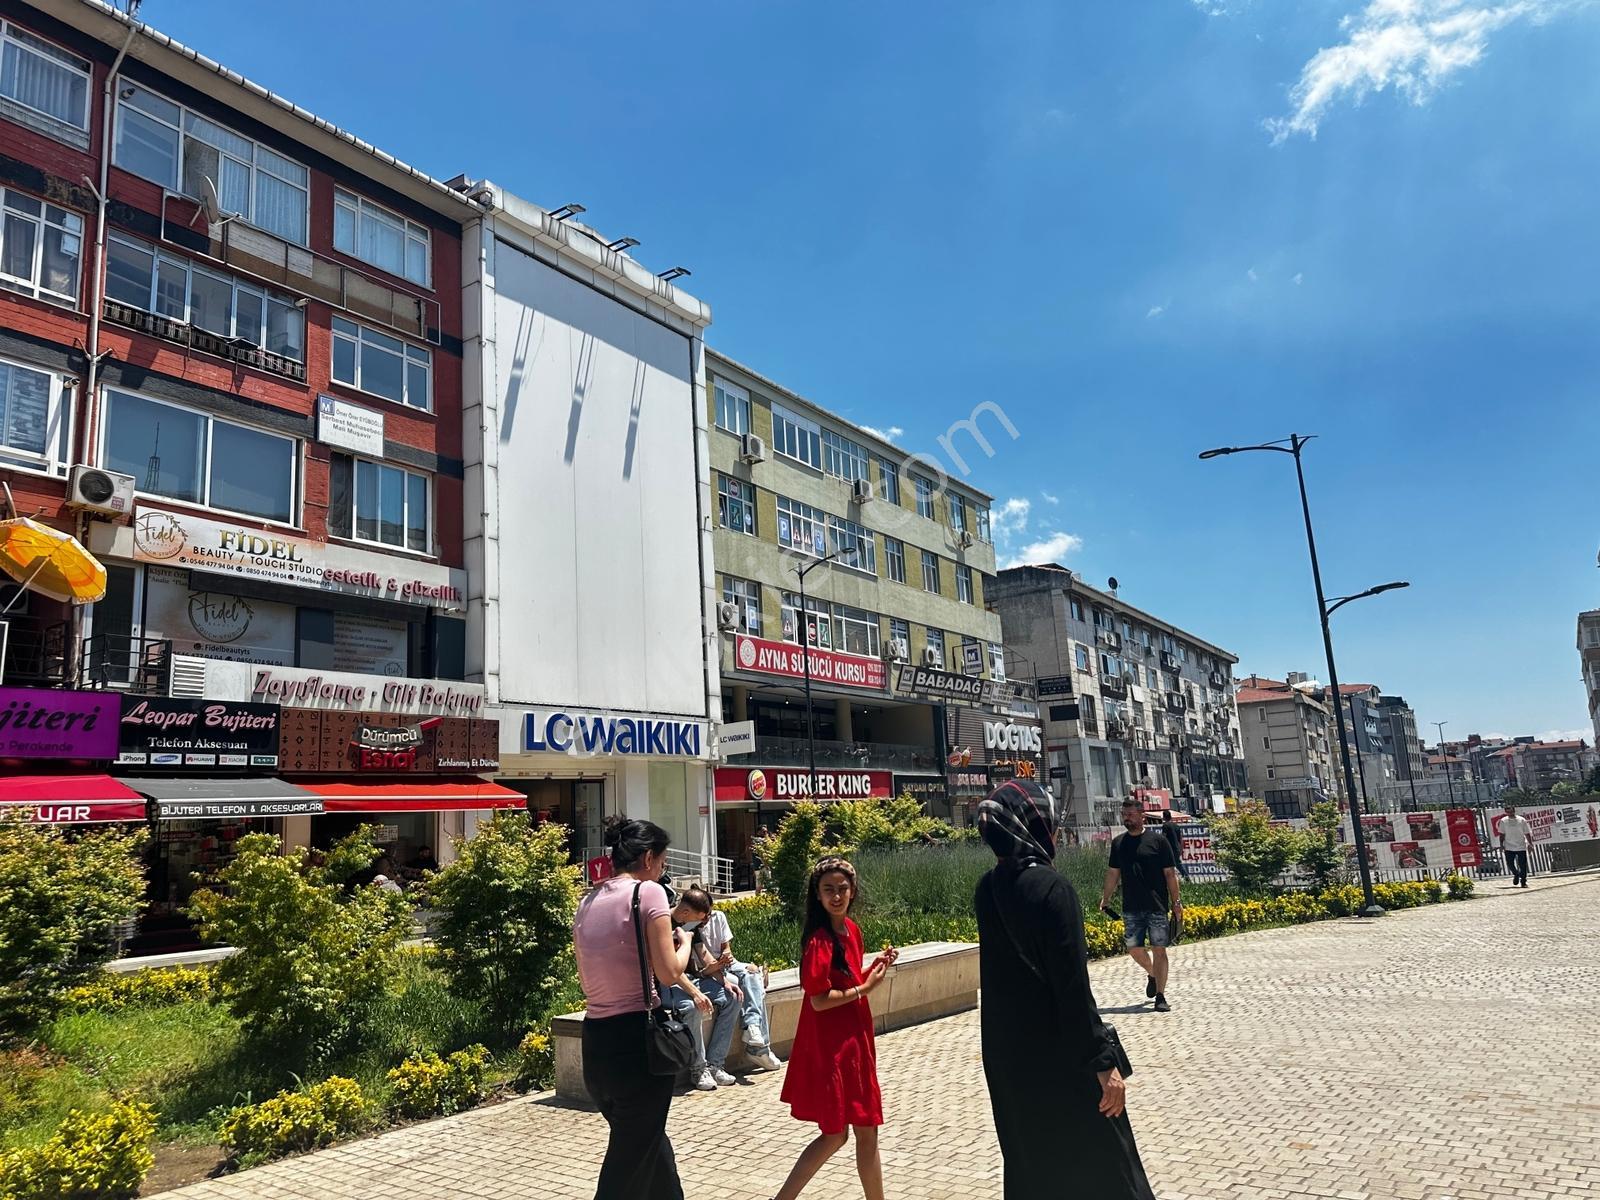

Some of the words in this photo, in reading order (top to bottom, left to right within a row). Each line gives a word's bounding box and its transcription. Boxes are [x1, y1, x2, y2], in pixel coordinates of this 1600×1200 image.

[321, 414, 346, 425] Serbest
[219, 529, 303, 564] FİDEL
[189, 558, 205, 566] 0546
[205, 560, 218, 569] 477
[226, 563, 235, 571] 04
[260, 569, 273, 577] 474
[272, 571, 280, 579] 94
[280, 572, 287, 580] 04
[193, 546, 234, 560] BEAUTY
[250, 556, 286, 570] TOUCH
[288, 563, 324, 576] STUDIO
[323, 568, 382, 589] estetik
[387, 578, 398, 592] &
[401, 580, 463, 603] güzellik
[205, 643, 250, 656] Fidelbeautyts
[759, 647, 789, 671] AYNA
[791, 650, 832, 679] SÜRÜCÜ
[835, 661, 866, 683] KURSU
[253, 671, 365, 704] Zayıflama
[420, 684, 483, 710] Bakımı
[916, 671, 981, 694] BABADAĞ
[122, 701, 198, 729] Leopar
[204, 705, 277, 732] Bujiteri
[147, 737, 192, 749] Telefon
[361, 728, 418, 744] Dürümcü
[524, 712, 574, 753] LC
[720, 736, 728, 744] LC
[984, 718, 1042, 758] DOĞTAŞ
[9, 741, 73, 752] Perakende
[361, 745, 417, 769] Esnaf
[123, 754, 146, 763] iPhone
[438, 758, 470, 768] Zırhlanmış
[471, 758, 479, 767] Et
[777, 773, 835, 796] BURGER
[838, 774, 871, 795] KING
[206, 805, 246, 815] TELEFON
[250, 805, 256, 813] &
[260, 803, 323, 813] AKSESUARLARI
